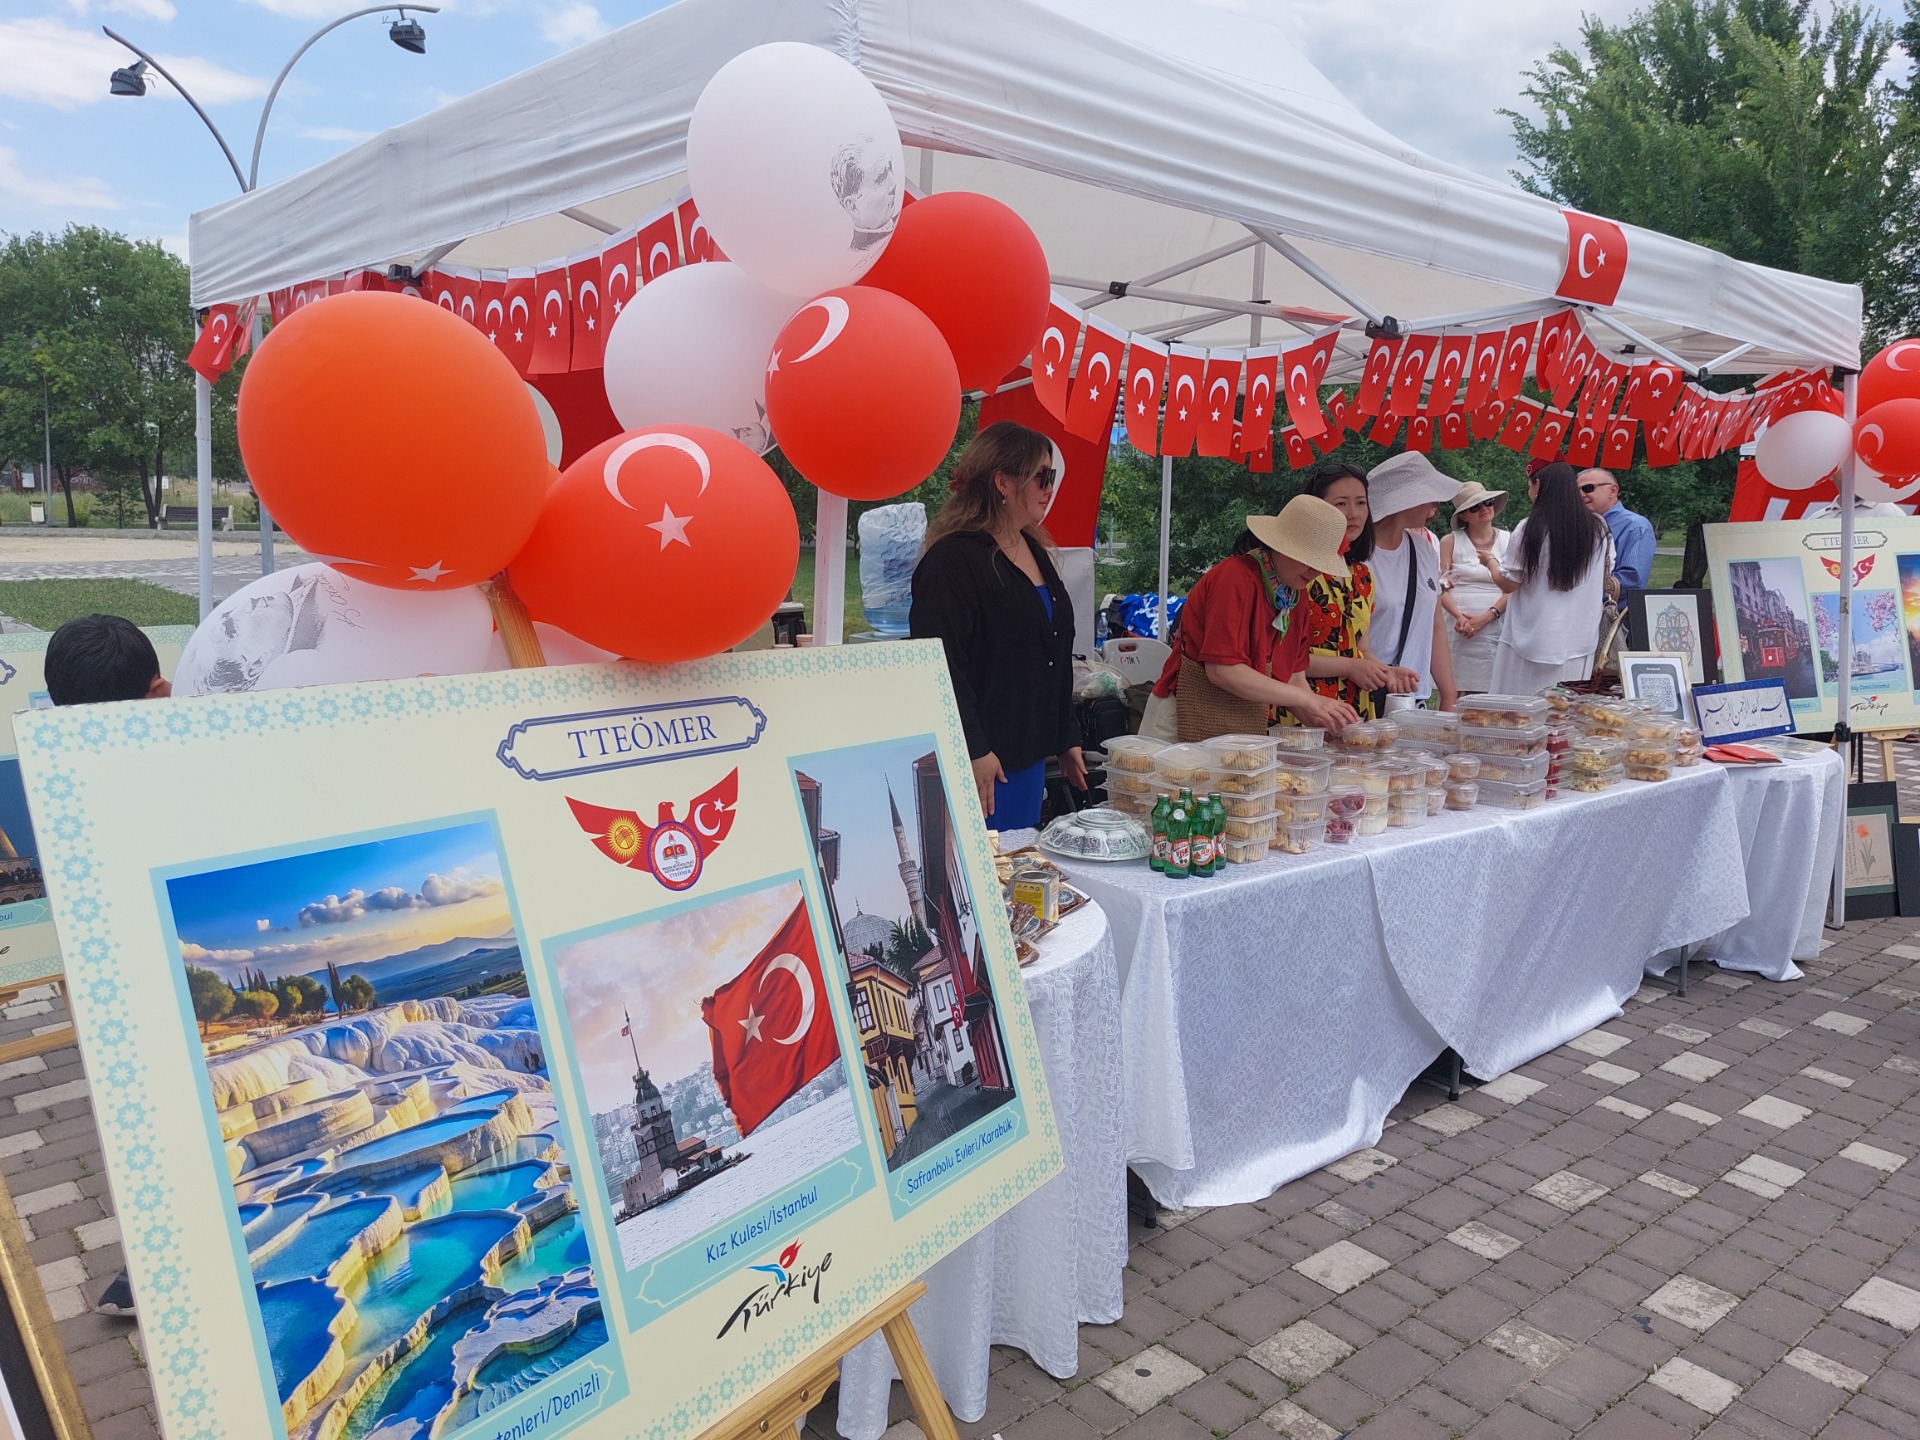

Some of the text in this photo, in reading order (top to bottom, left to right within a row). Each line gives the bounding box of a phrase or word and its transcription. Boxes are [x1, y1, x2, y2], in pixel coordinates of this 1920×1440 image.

[1821, 535, 1870, 546] TTEER
[567, 715, 718, 759] TTEÖMER
[907, 1118, 1013, 1193] Safranbolu Evleri/Karabük
[706, 1186, 818, 1264] Kız Kulesi/İstanbul
[716, 1252, 833, 1340] Türkiye
[493, 1373, 600, 1440] tenleri/Denizli
